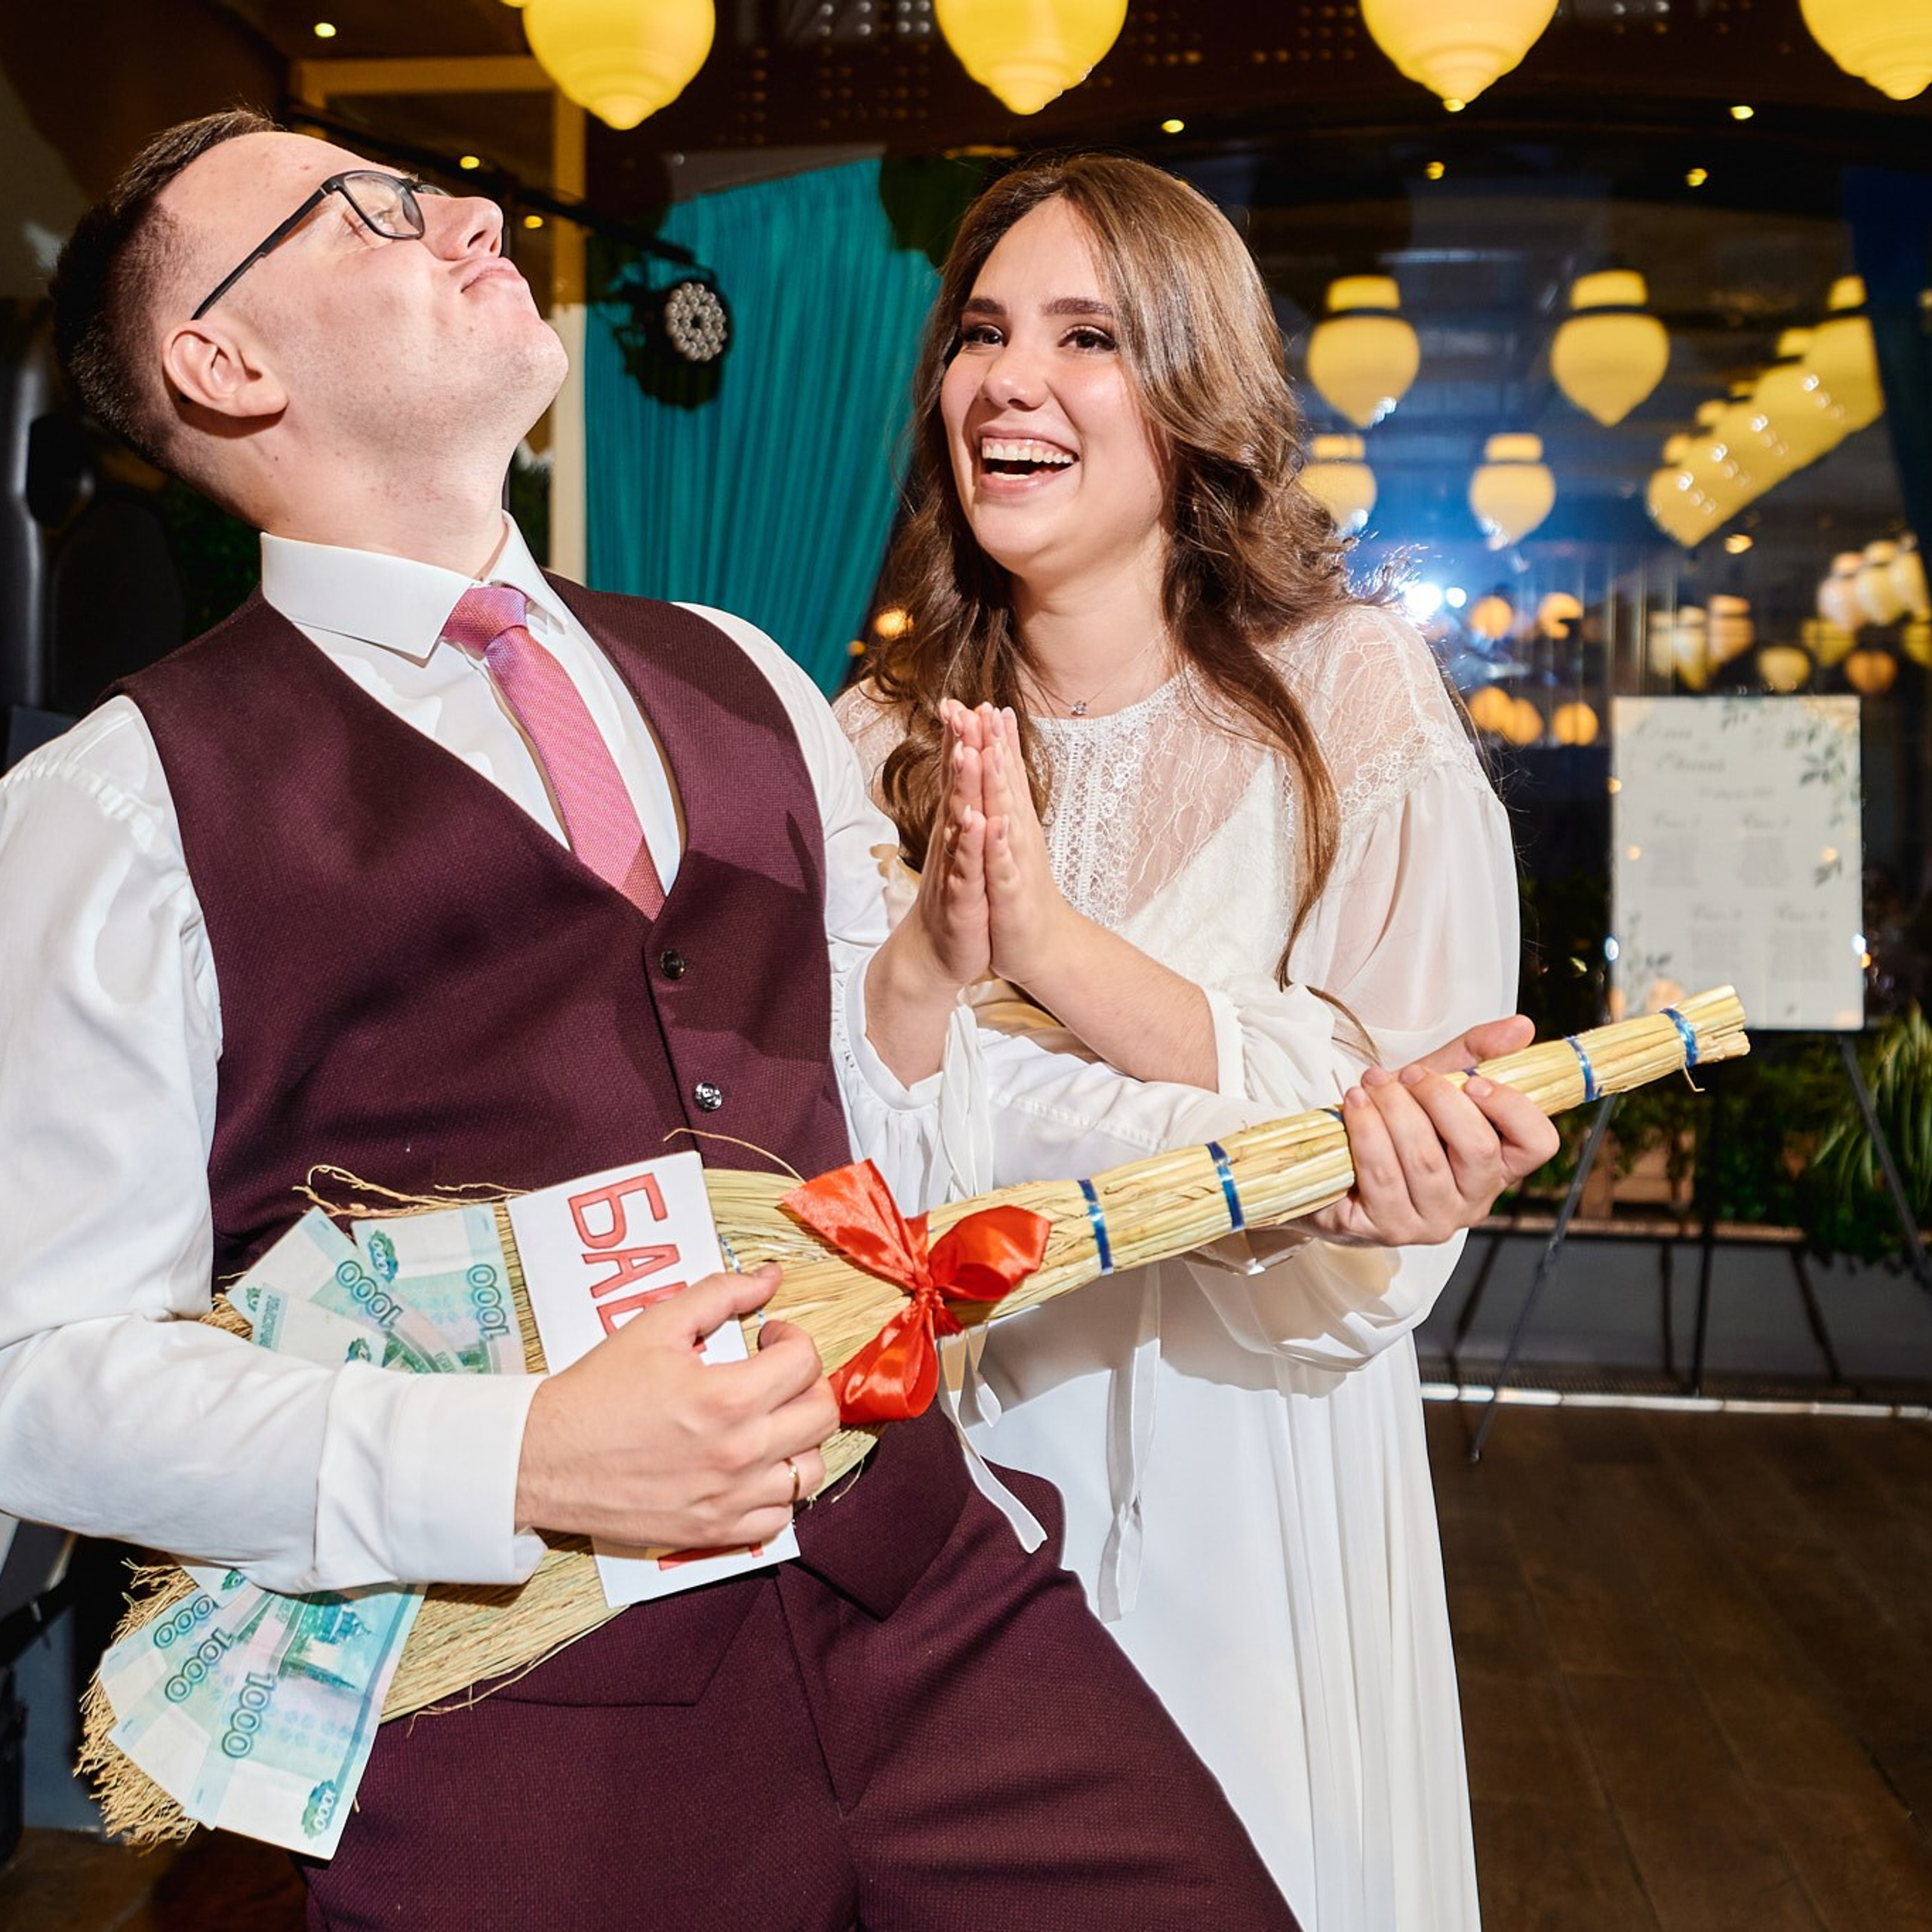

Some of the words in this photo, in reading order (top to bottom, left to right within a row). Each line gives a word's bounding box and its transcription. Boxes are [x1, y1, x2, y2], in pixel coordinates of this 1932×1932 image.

[336, 1260, 404, 1327] 1000
[466, 1263, 510, 1341] 1000
[153, 1595, 219, 1649] 000
[165, 1627, 233, 1703] 1000
[221, 1671, 277, 1759] 1000
